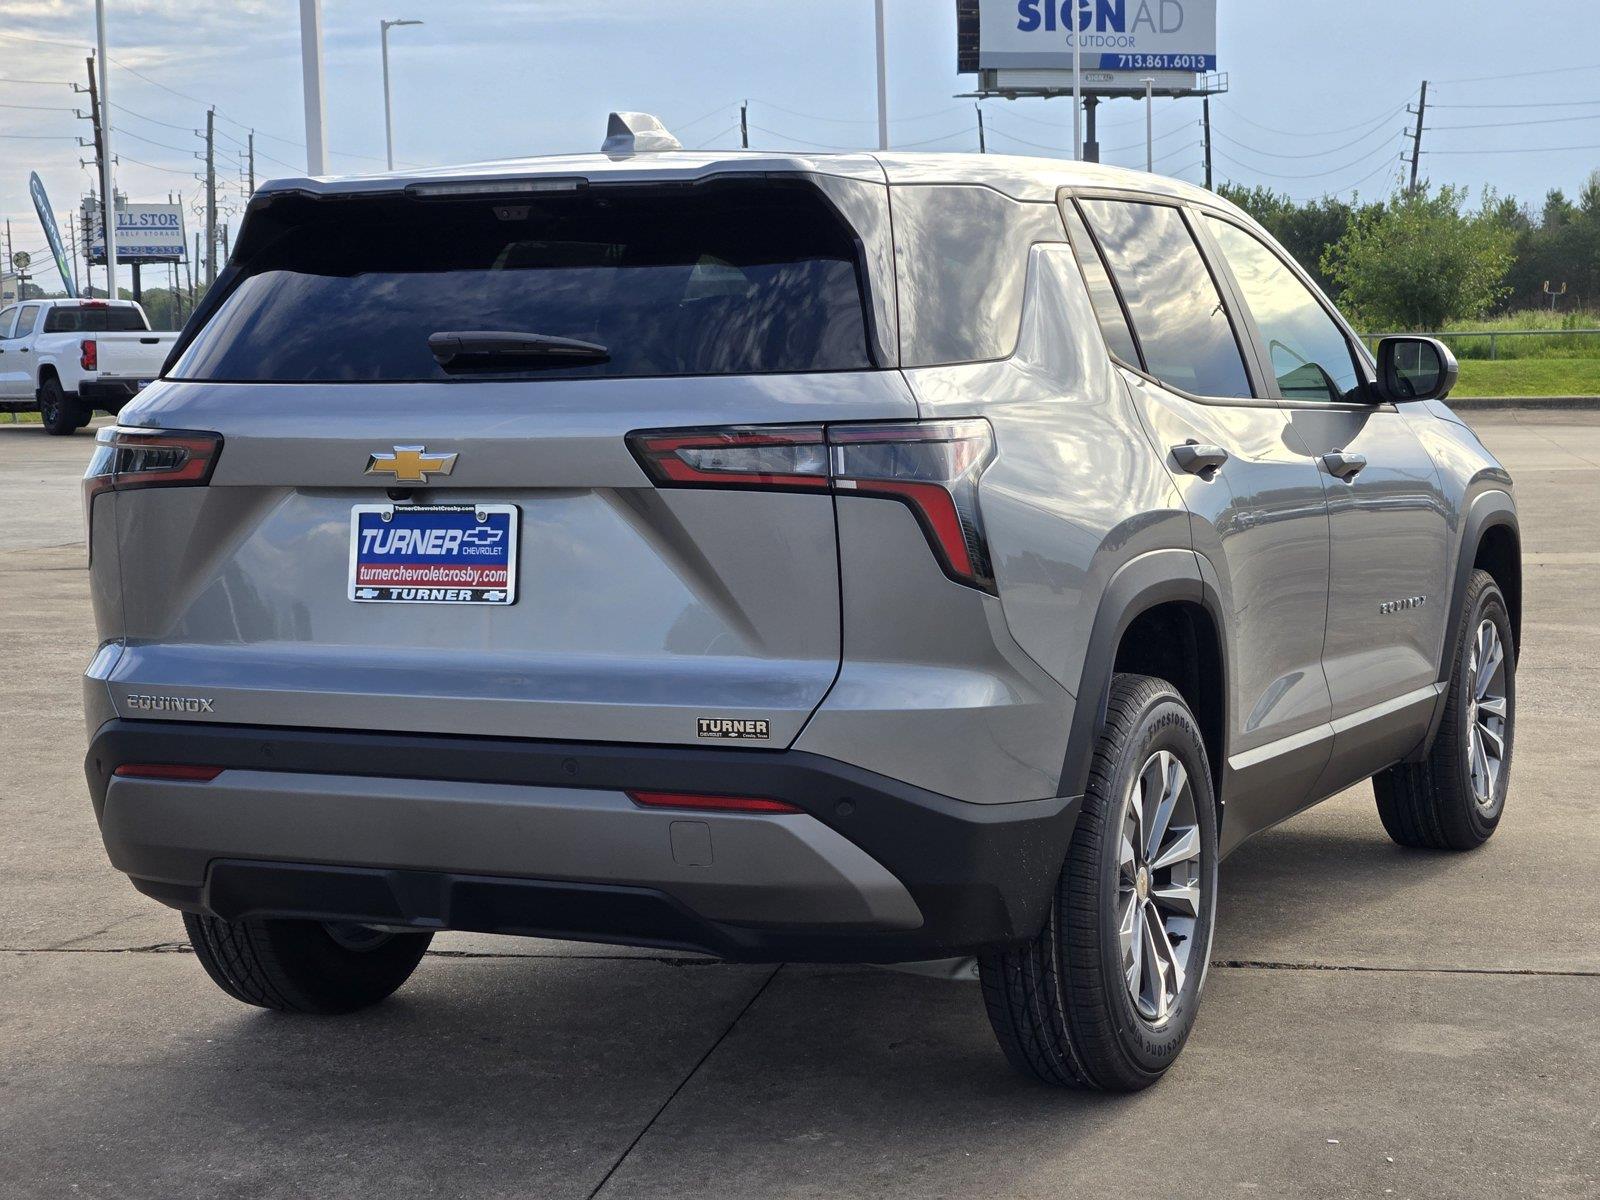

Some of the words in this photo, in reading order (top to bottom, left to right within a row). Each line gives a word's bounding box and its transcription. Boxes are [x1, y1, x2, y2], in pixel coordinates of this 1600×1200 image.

[1066, 34, 1136, 48] OUTDOOR
[1118, 55, 1206, 68] 713.861.6013
[140, 213, 179, 226] STOR
[362, 528, 463, 555] TURNER
[463, 547, 502, 555] CHEVROLET
[360, 565, 507, 585] turnerchevroletcrosby.com
[390, 589, 473, 601] TURNER
[127, 694, 214, 712] EQUINOX
[699, 719, 767, 733] TURNER
[1147, 711, 1190, 734] Firestone
